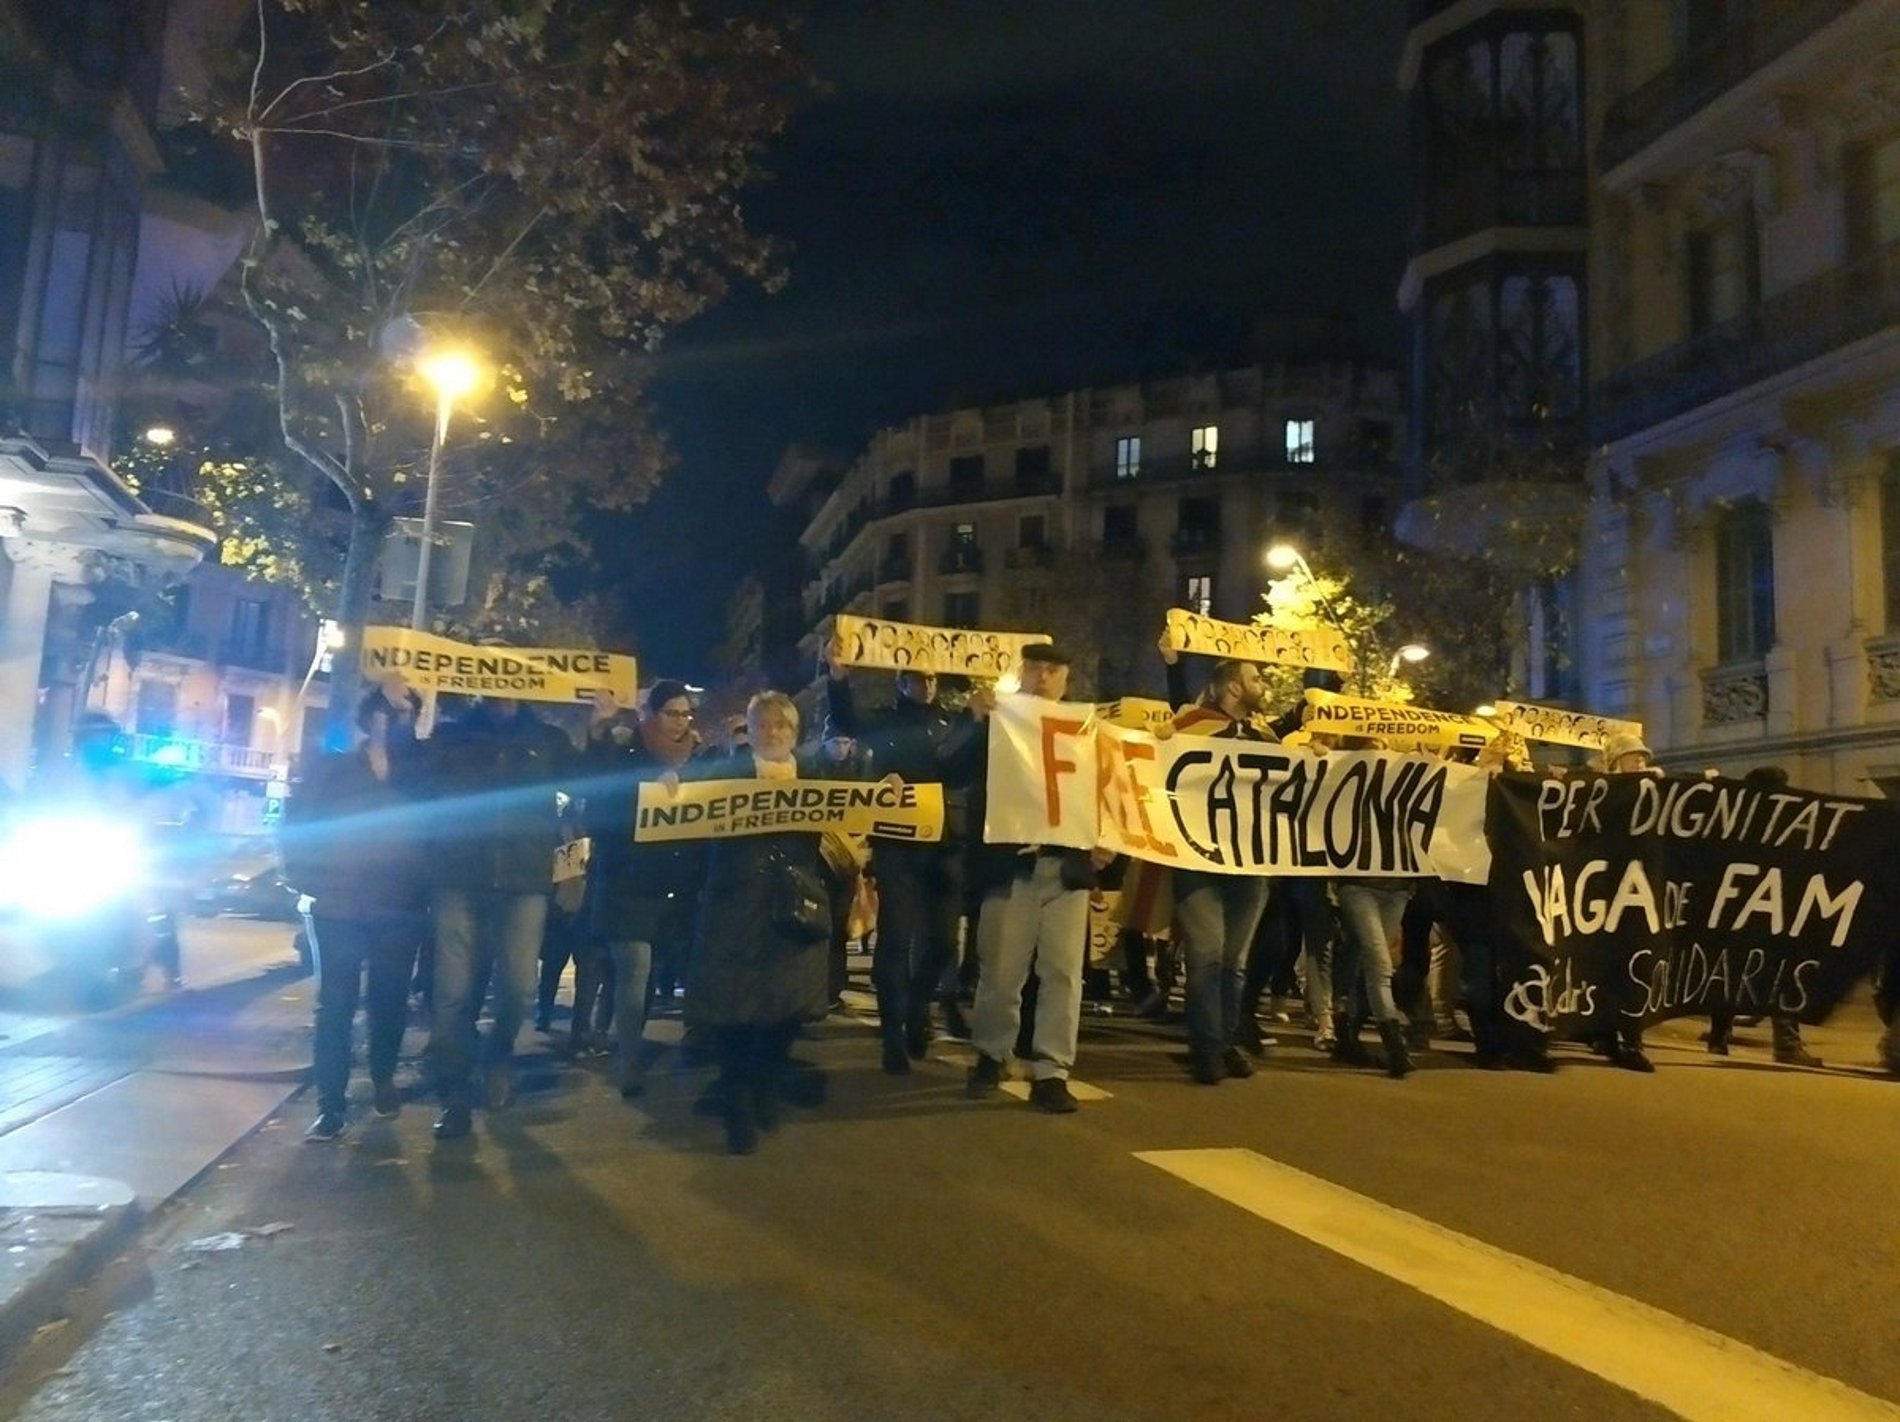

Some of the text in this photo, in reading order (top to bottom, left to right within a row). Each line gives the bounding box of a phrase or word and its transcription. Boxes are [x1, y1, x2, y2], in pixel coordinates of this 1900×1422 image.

[436, 674, 546, 690] FREEDOM
[1366, 722, 1441, 735] FREEDOM
[639, 786, 918, 829] INDEPENDENCE
[731, 808, 845, 832] FREEDOM
[1165, 750, 1448, 874] CATALONIA
[1537, 778, 1865, 852] PER DIGNITAT
[1522, 859, 1865, 948] VAGA DE FAM
